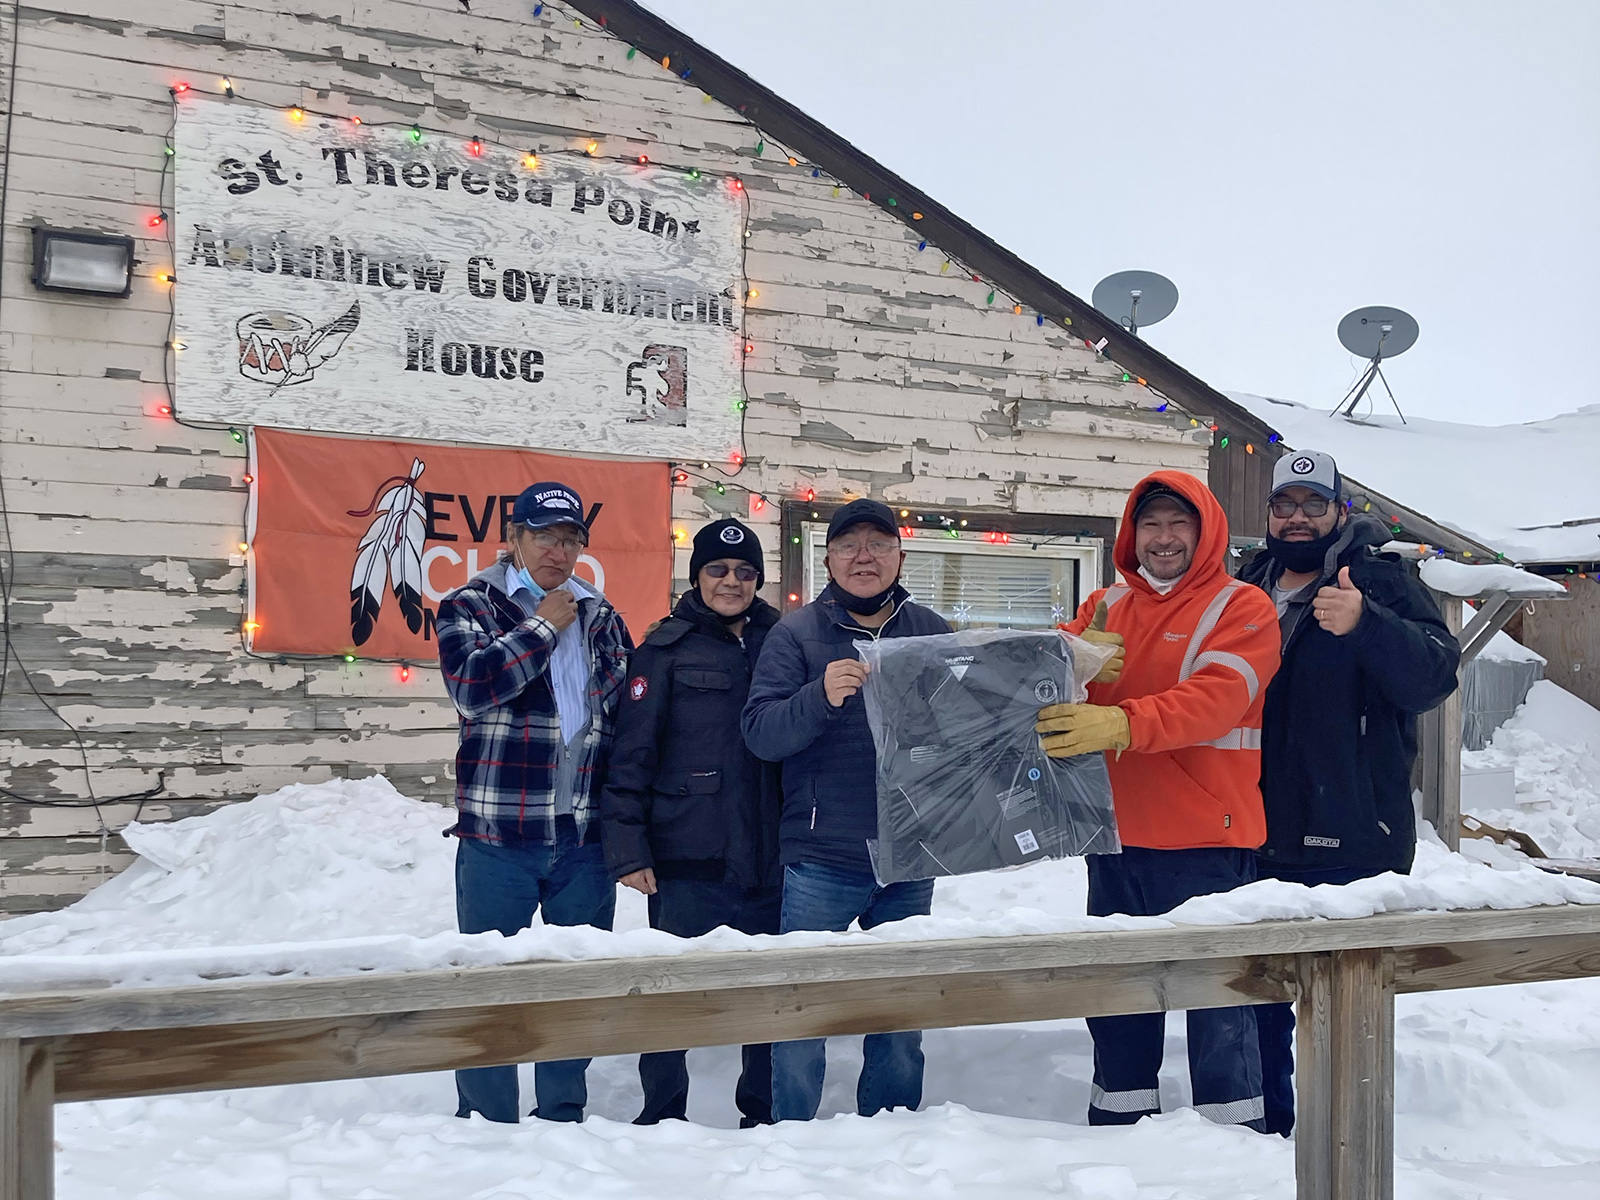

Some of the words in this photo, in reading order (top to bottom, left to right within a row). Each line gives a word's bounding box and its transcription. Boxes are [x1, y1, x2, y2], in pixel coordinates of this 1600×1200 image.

[217, 149, 303, 195] St.
[322, 148, 552, 207] Theresa
[404, 327, 545, 383] House
[535, 490, 562, 503] NATIVE
[1305, 837, 1339, 847] DAKOTA
